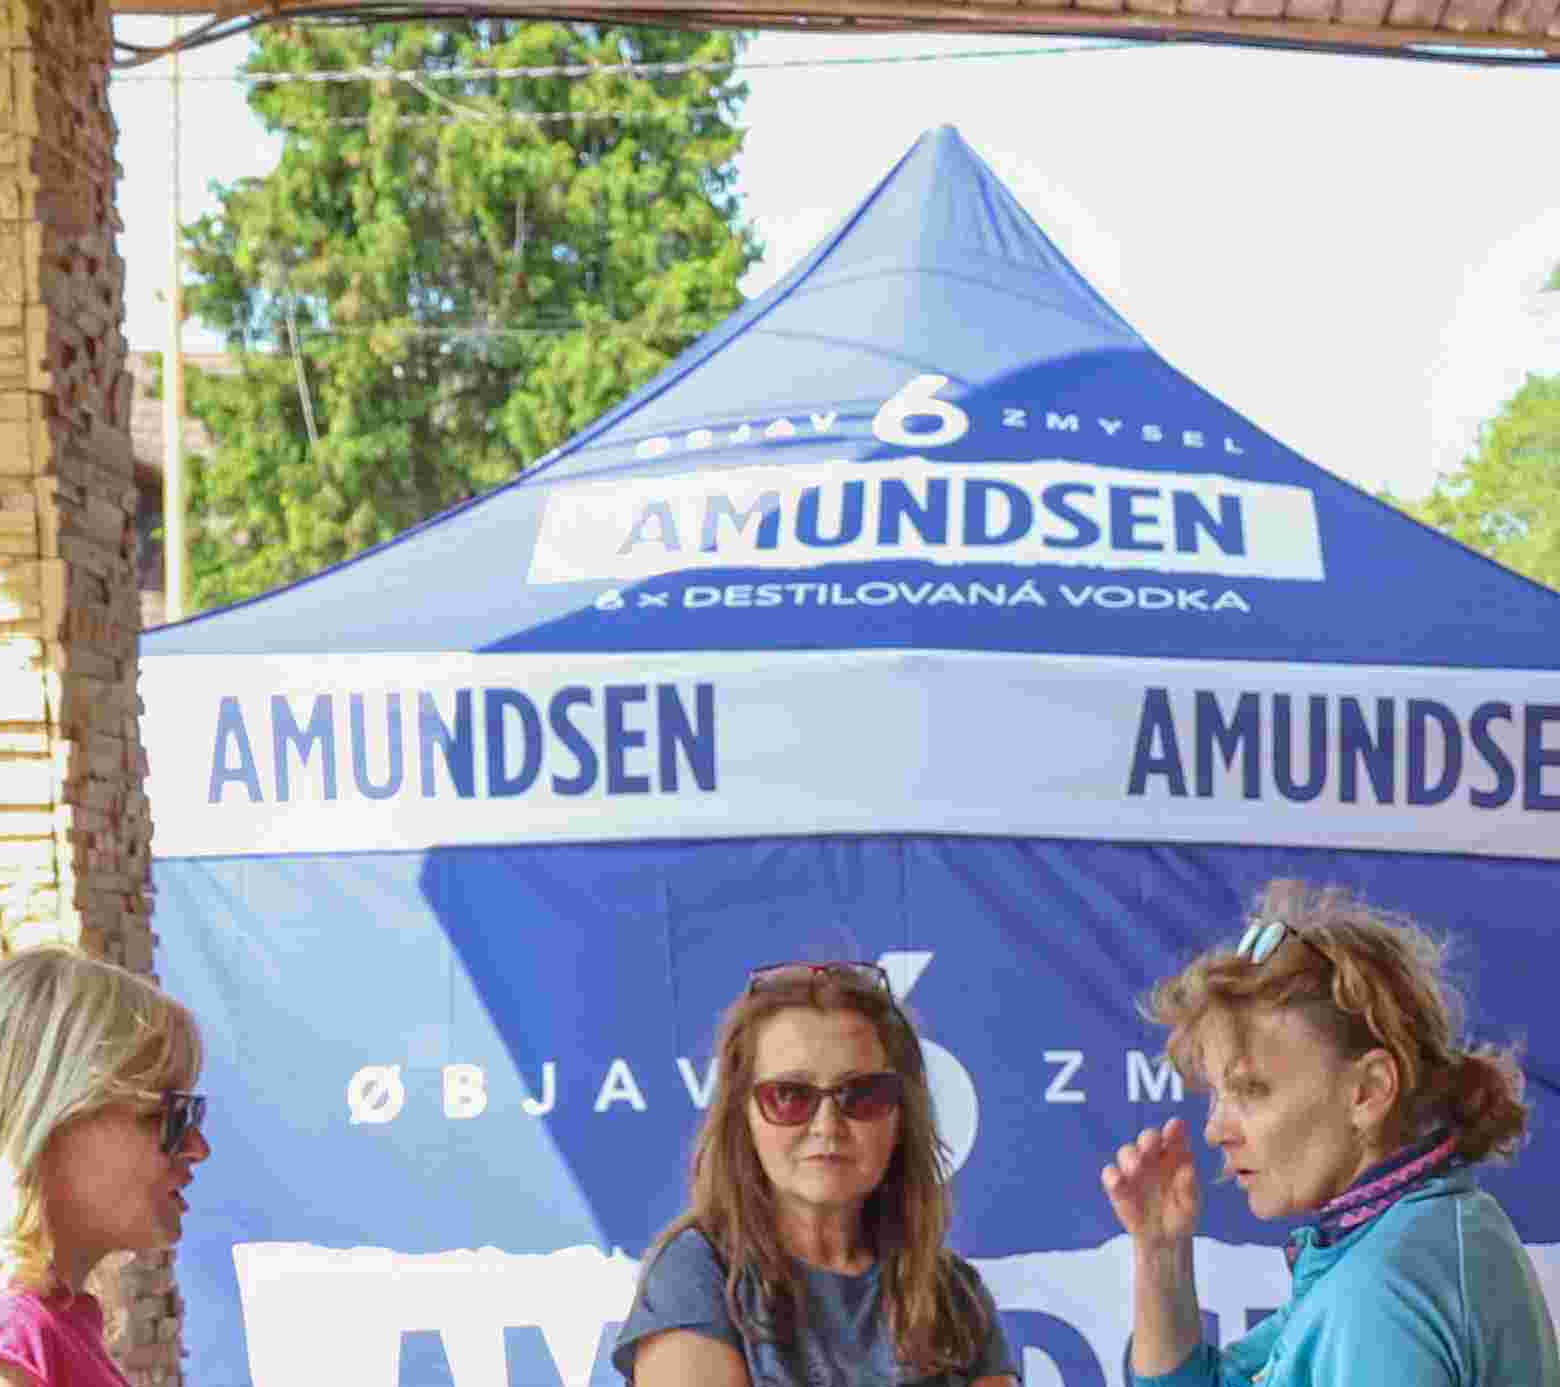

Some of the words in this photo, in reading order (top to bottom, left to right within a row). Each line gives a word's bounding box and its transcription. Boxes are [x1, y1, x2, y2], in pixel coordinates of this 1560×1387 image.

[872, 374, 969, 448] 6
[1001, 408, 1244, 455] ZMYSEL
[616, 476, 1248, 558] AMUNDSEN
[683, 580, 1047, 608] DESTILOVANÁ
[1059, 584, 1251, 612] VODKA
[207, 683, 717, 803] AMUNDSEN
